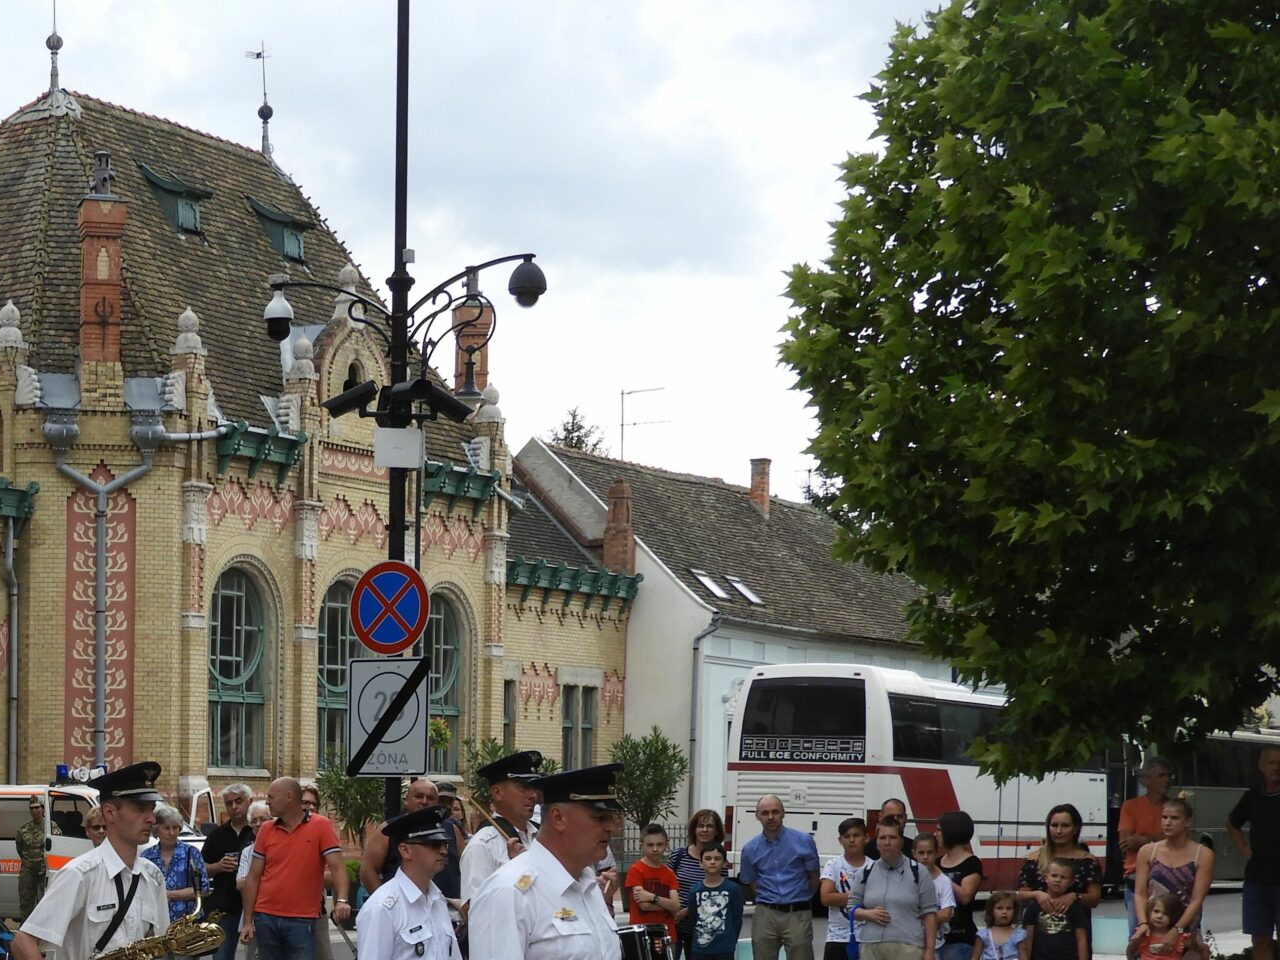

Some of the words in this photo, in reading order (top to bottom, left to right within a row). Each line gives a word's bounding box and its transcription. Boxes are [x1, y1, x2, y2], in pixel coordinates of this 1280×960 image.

[367, 750, 409, 765] ZÓNA
[741, 750, 766, 759] FULL
[769, 751, 791, 759] ECE
[793, 752, 864, 761] CONFORMITY
